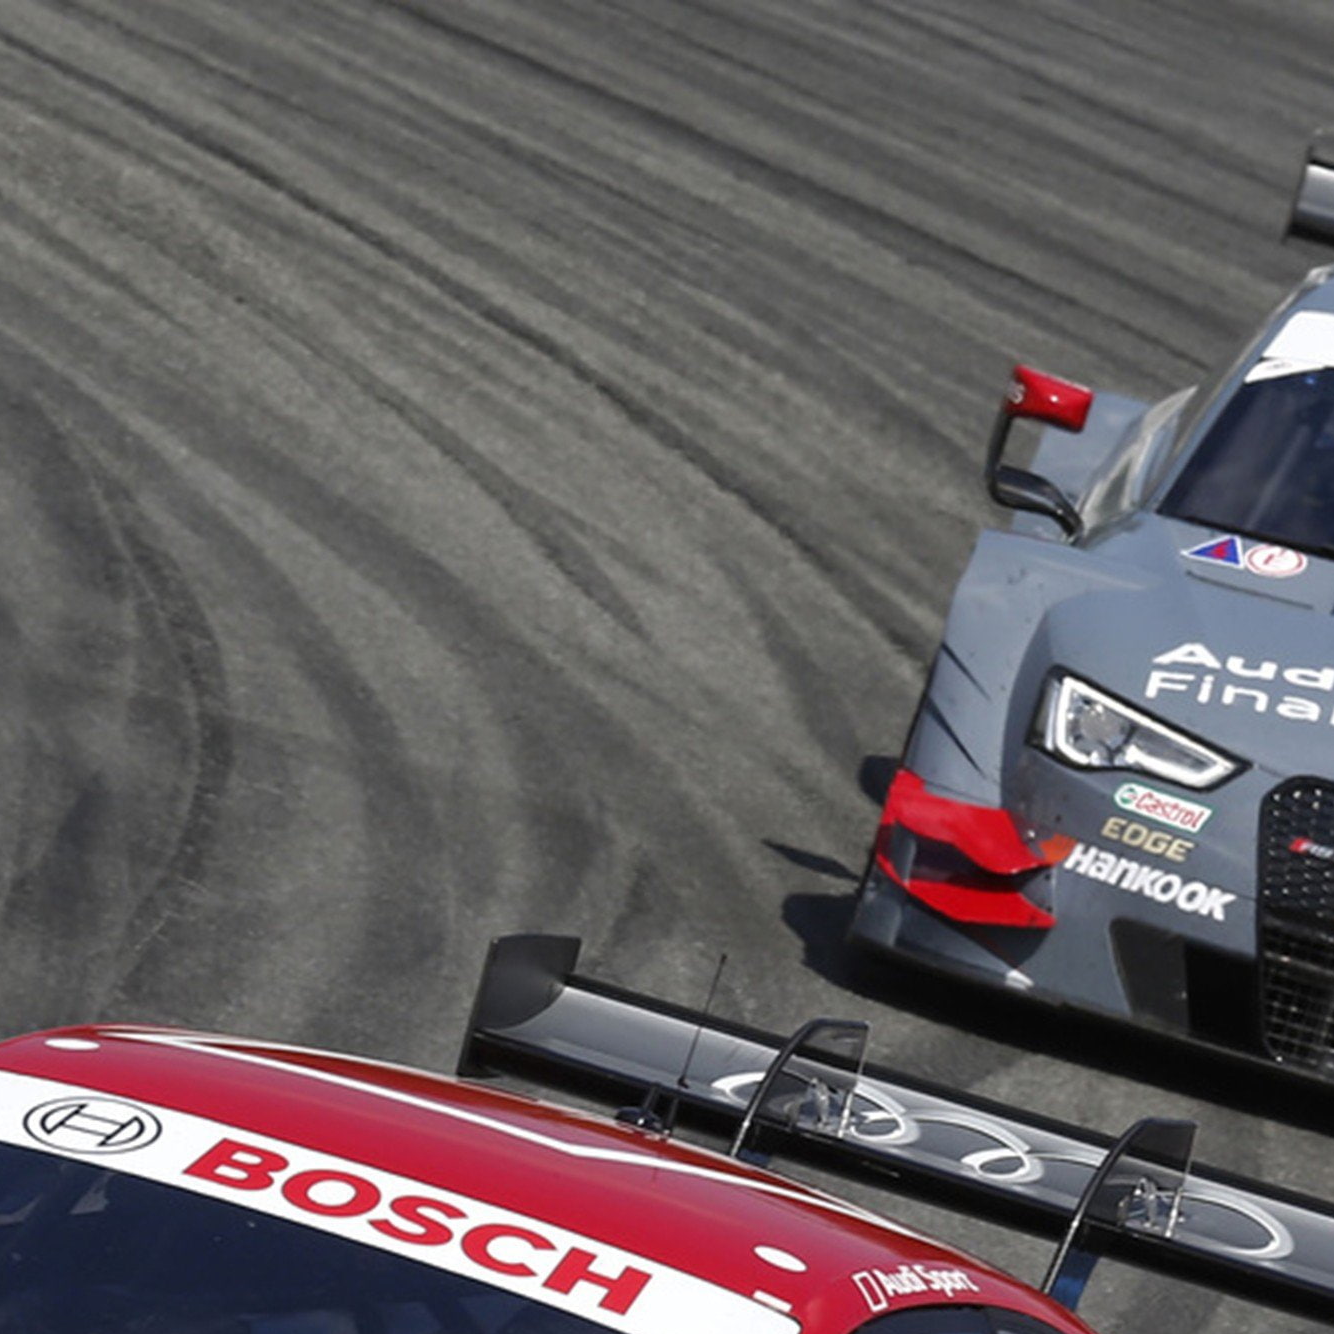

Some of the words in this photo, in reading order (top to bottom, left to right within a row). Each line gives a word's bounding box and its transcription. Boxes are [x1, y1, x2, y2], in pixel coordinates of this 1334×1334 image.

[1134, 792, 1205, 829] Castrol
[1100, 816, 1195, 863] EDGE
[182, 1137, 653, 1316] BOSCH
